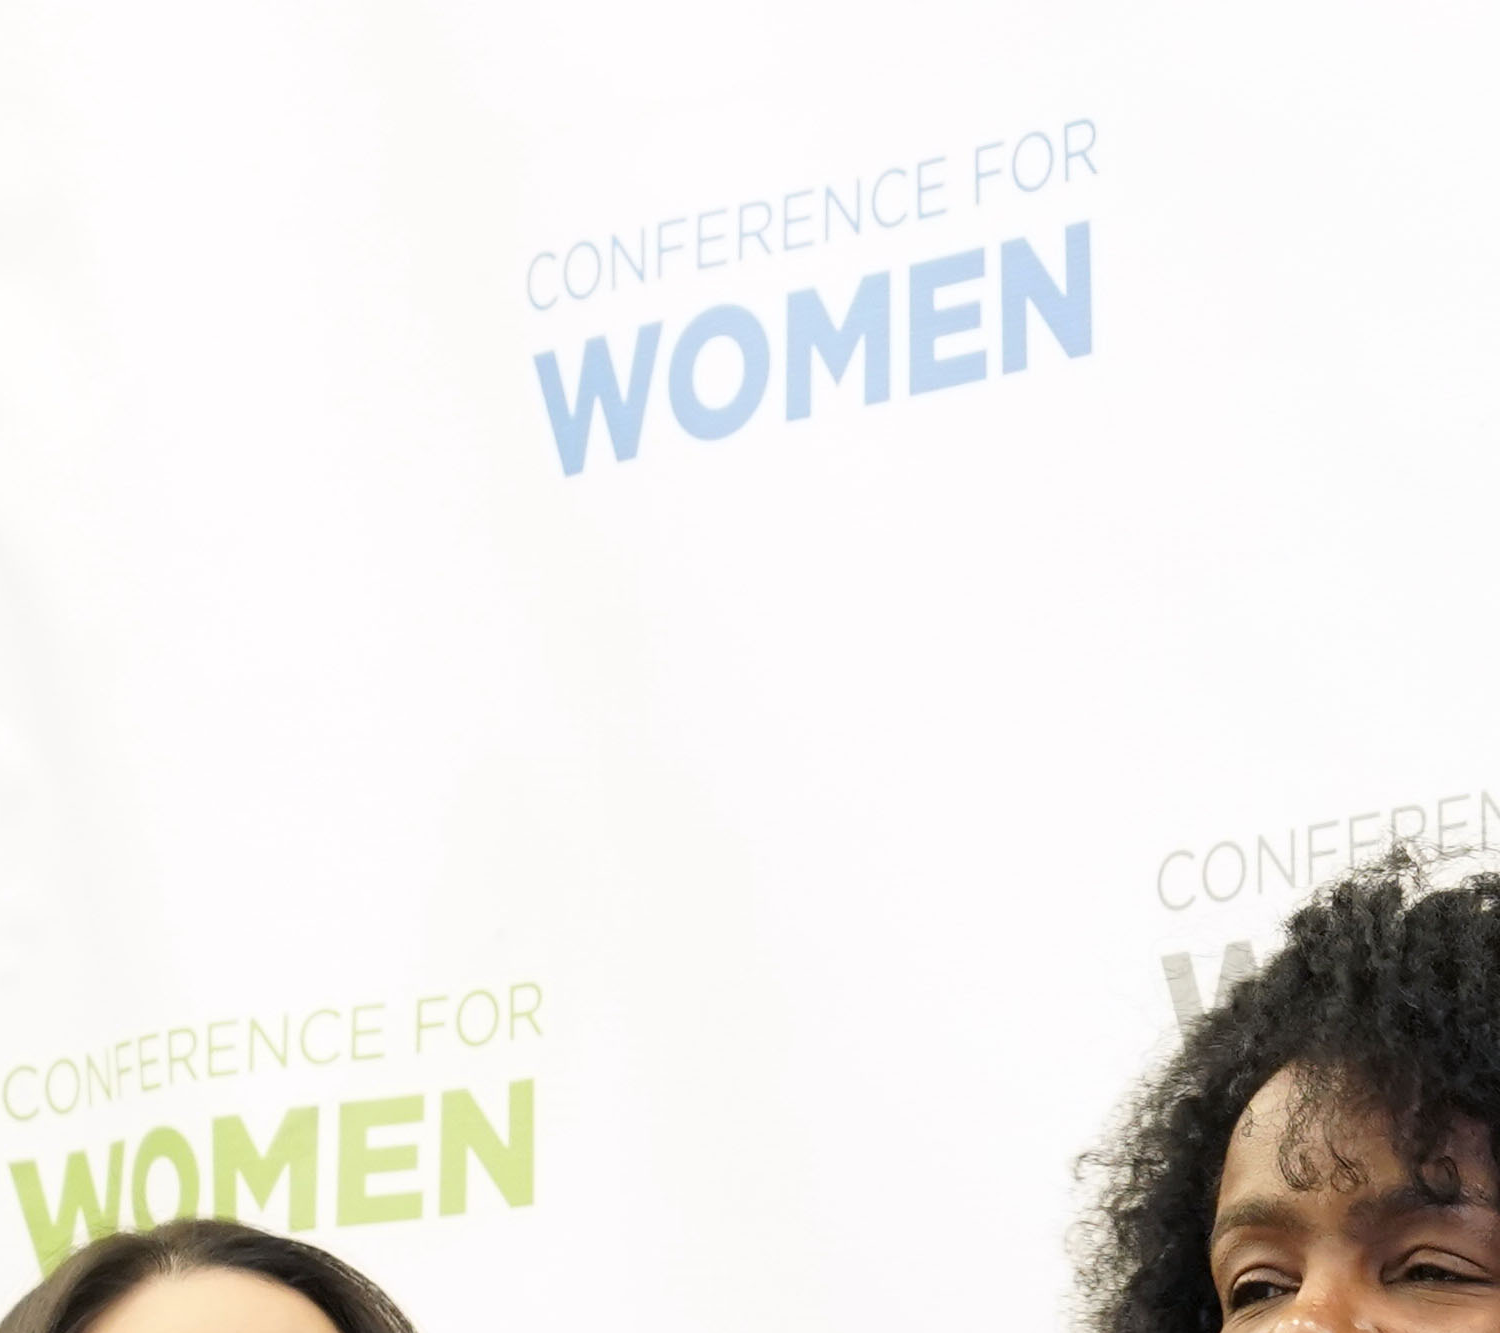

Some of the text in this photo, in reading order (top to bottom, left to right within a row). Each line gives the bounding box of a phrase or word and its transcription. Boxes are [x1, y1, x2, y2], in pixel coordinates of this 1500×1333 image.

[526, 116, 1100, 312] CONFERENCE FOR
[533, 219, 1094, 478] WOMEN
[2, 981, 544, 1122] CONFERENCE FOR
[8, 1077, 535, 1281] WOMEN
